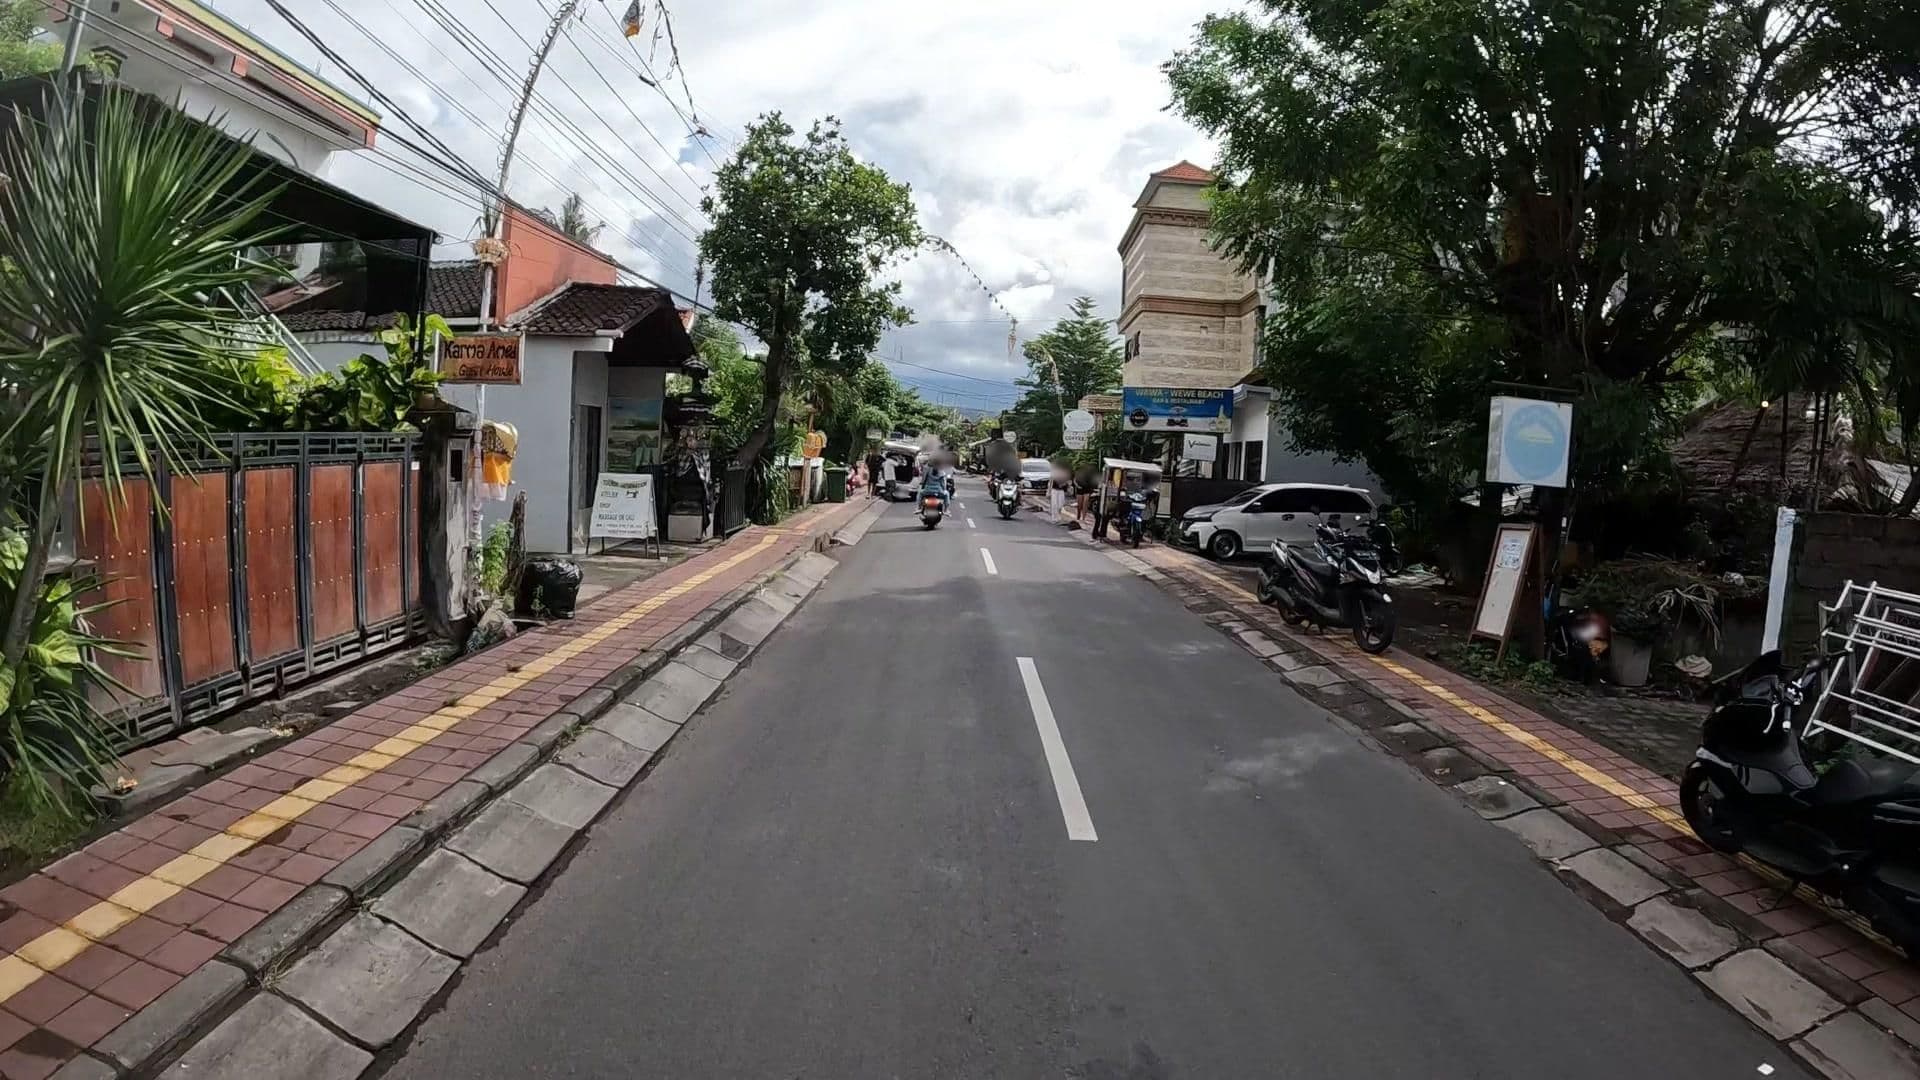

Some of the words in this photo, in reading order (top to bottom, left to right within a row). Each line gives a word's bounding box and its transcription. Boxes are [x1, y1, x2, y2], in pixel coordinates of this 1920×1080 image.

[444, 341, 485, 359] Karma
[486, 341, 517, 359] Amed
[1170, 390, 1197, 398] WEWE
[1197, 390, 1224, 399] BEACH
